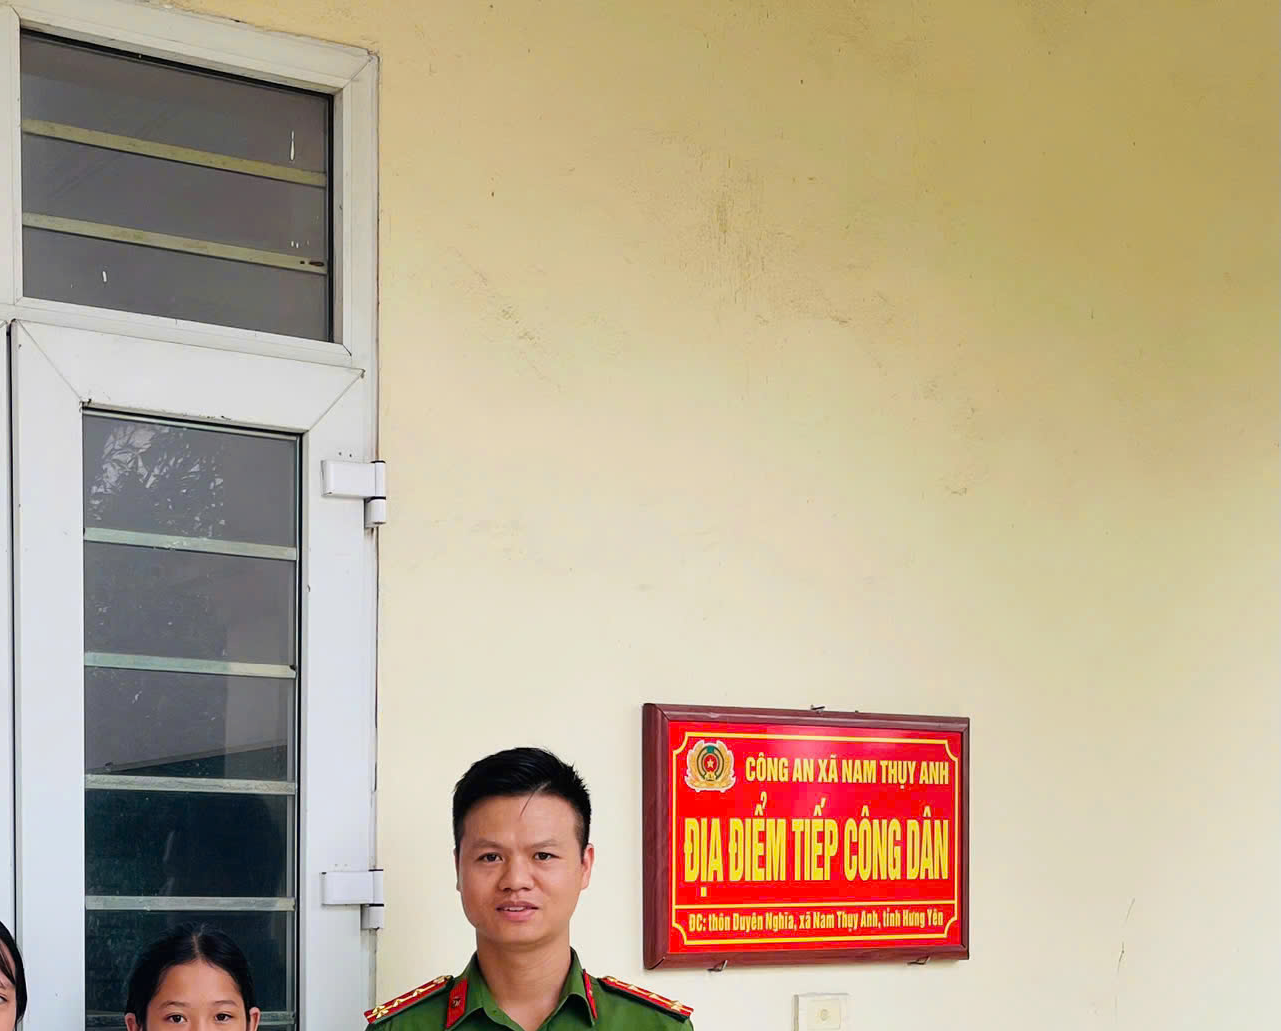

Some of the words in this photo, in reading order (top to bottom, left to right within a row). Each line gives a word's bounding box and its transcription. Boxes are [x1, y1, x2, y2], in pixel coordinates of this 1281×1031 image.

[745, 752, 789, 782] CÔNG
[792, 757, 815, 783] AN
[818, 754, 839, 784] XÃ
[842, 758, 877, 784] NAM
[880, 760, 917, 790] THỤY
[919, 761, 949, 785] ANH
[684, 818, 724, 897] ĐỊA
[728, 791, 786, 882] ĐIỂM
[791, 797, 839, 881] TIẾP
[843, 805, 902, 881] CÔNG
[907, 806, 949, 879] DÂN
[689, 913, 706, 931] ĐC:
[709, 913, 731, 931] thôn
[733, 912, 763, 932] Duyên
[765, 912, 797, 932] Nghĩa,
[799, 912, 811, 928] xã
[813, 912, 835, 928] Nam
[837, 911, 858, 932] Thụy
[861, 910, 881, 928] Anh,
[883, 908, 901, 928] tỉnh
[903, 909, 925, 928] Hưng
[927, 909, 943, 926] Yên
